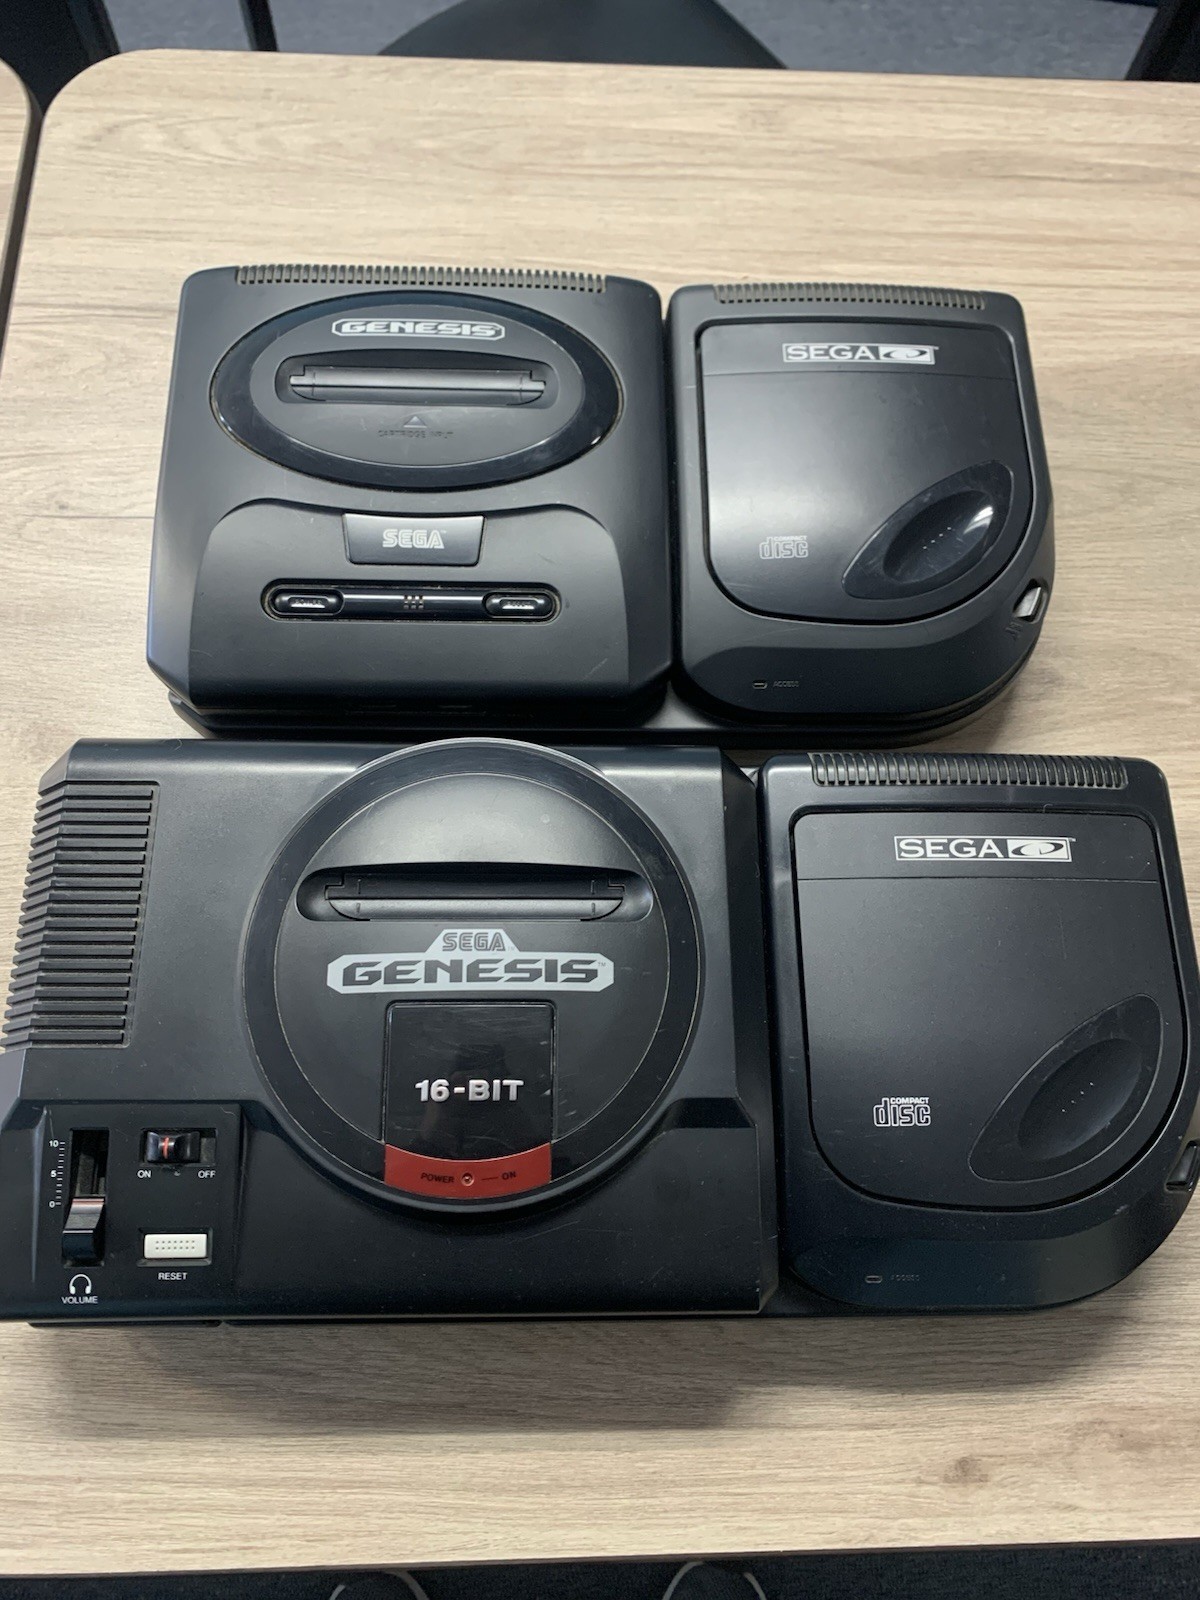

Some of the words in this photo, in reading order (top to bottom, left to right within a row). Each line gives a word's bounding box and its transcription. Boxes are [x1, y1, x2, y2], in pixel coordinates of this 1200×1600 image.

[341, 321, 500, 337] GENESIS
[786, 345, 875, 360] SEGA
[382, 529, 445, 549] SEGA
[899, 838, 1004, 858] SEGA
[442, 931, 506, 952] SEGA
[342, 958, 600, 987] GENESIS
[414, 1078, 524, 1102] 16-BIT
[873, 1097, 931, 1127] disc
[50, 1170, 57, 1178] 5
[137, 1170, 151, 1178] ON
[197, 1170, 216, 1179] OFF
[420, 1172, 455, 1184] POWER
[501, 1170, 517, 1180] ON
[49, 1200, 55, 1208] 0
[158, 1272, 188, 1280] RESET
[61, 1296, 98, 1304] VOLUME
